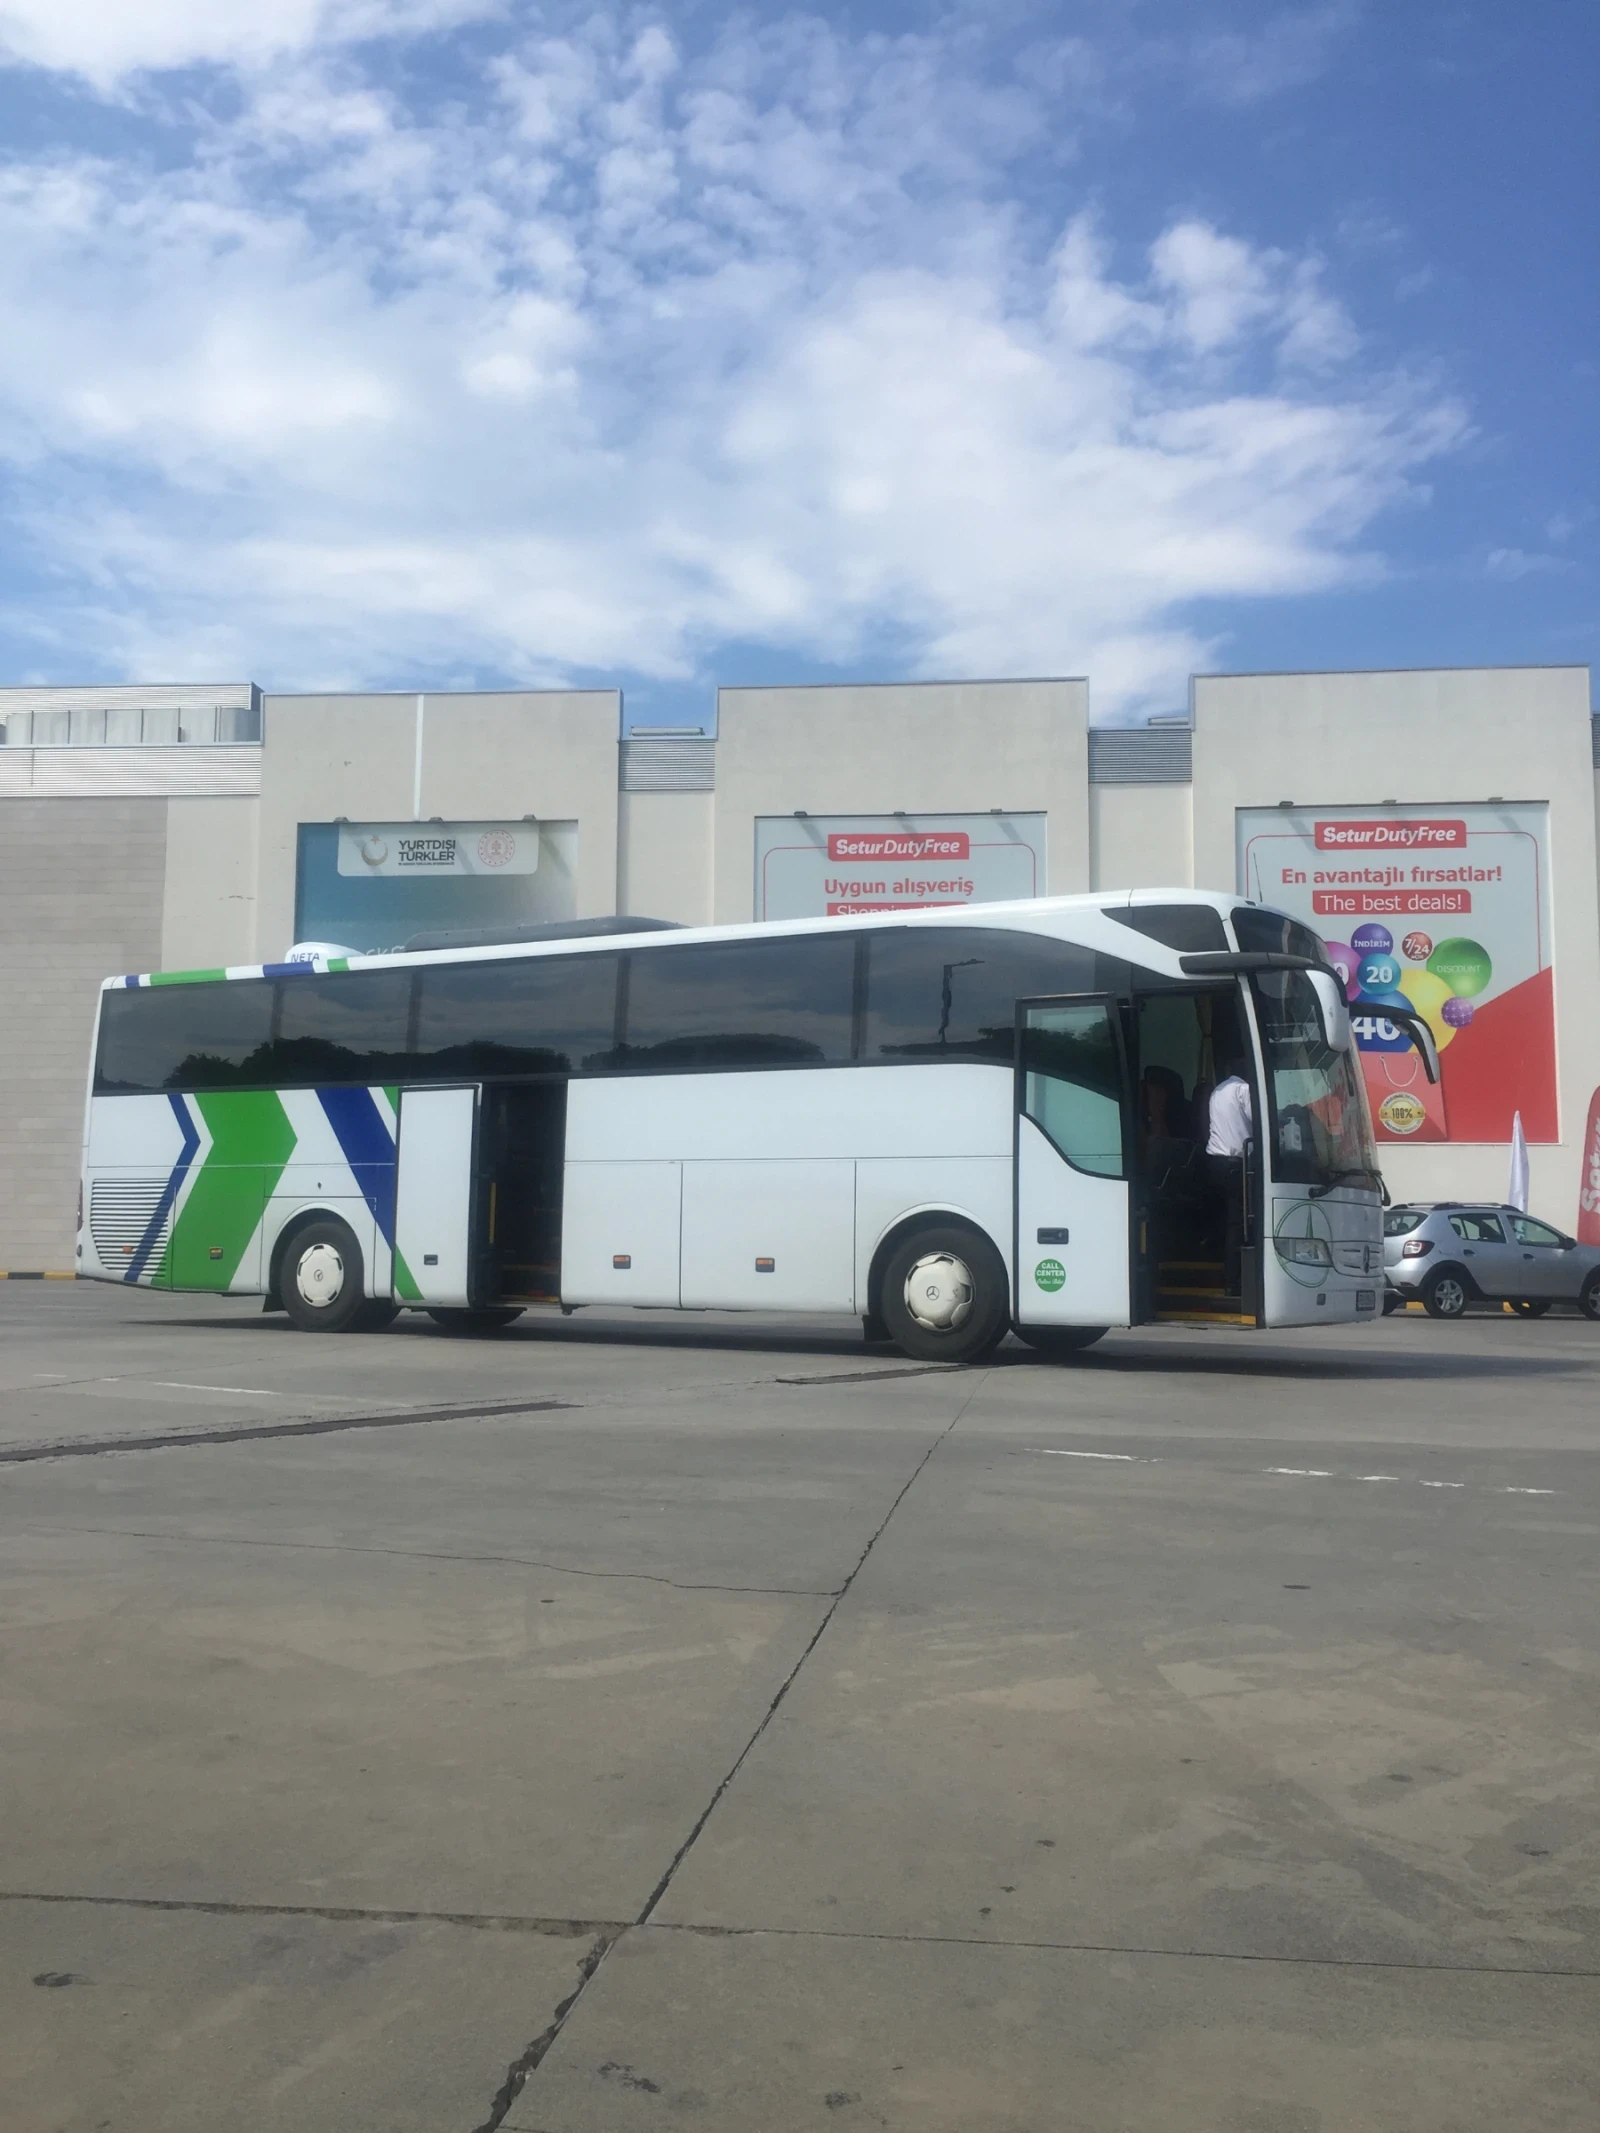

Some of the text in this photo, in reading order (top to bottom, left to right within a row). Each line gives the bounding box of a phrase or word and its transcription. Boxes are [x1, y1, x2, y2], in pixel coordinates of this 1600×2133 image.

[398, 839, 456, 851] YURTDIŞI
[398, 849, 455, 861] TÜRKLER
[1282, 865, 1502, 887] En avantajlı fırsatlar!
[824, 877, 974, 898] Uygun alışveriş
[1320, 893, 1462, 911] The best deals!
[1404, 938, 1430, 955] 7/24
[1366, 966, 1393, 984] 20
[1436, 964, 1482, 973] DISCOUNT
[1391, 1107, 1413, 1119] 100%
